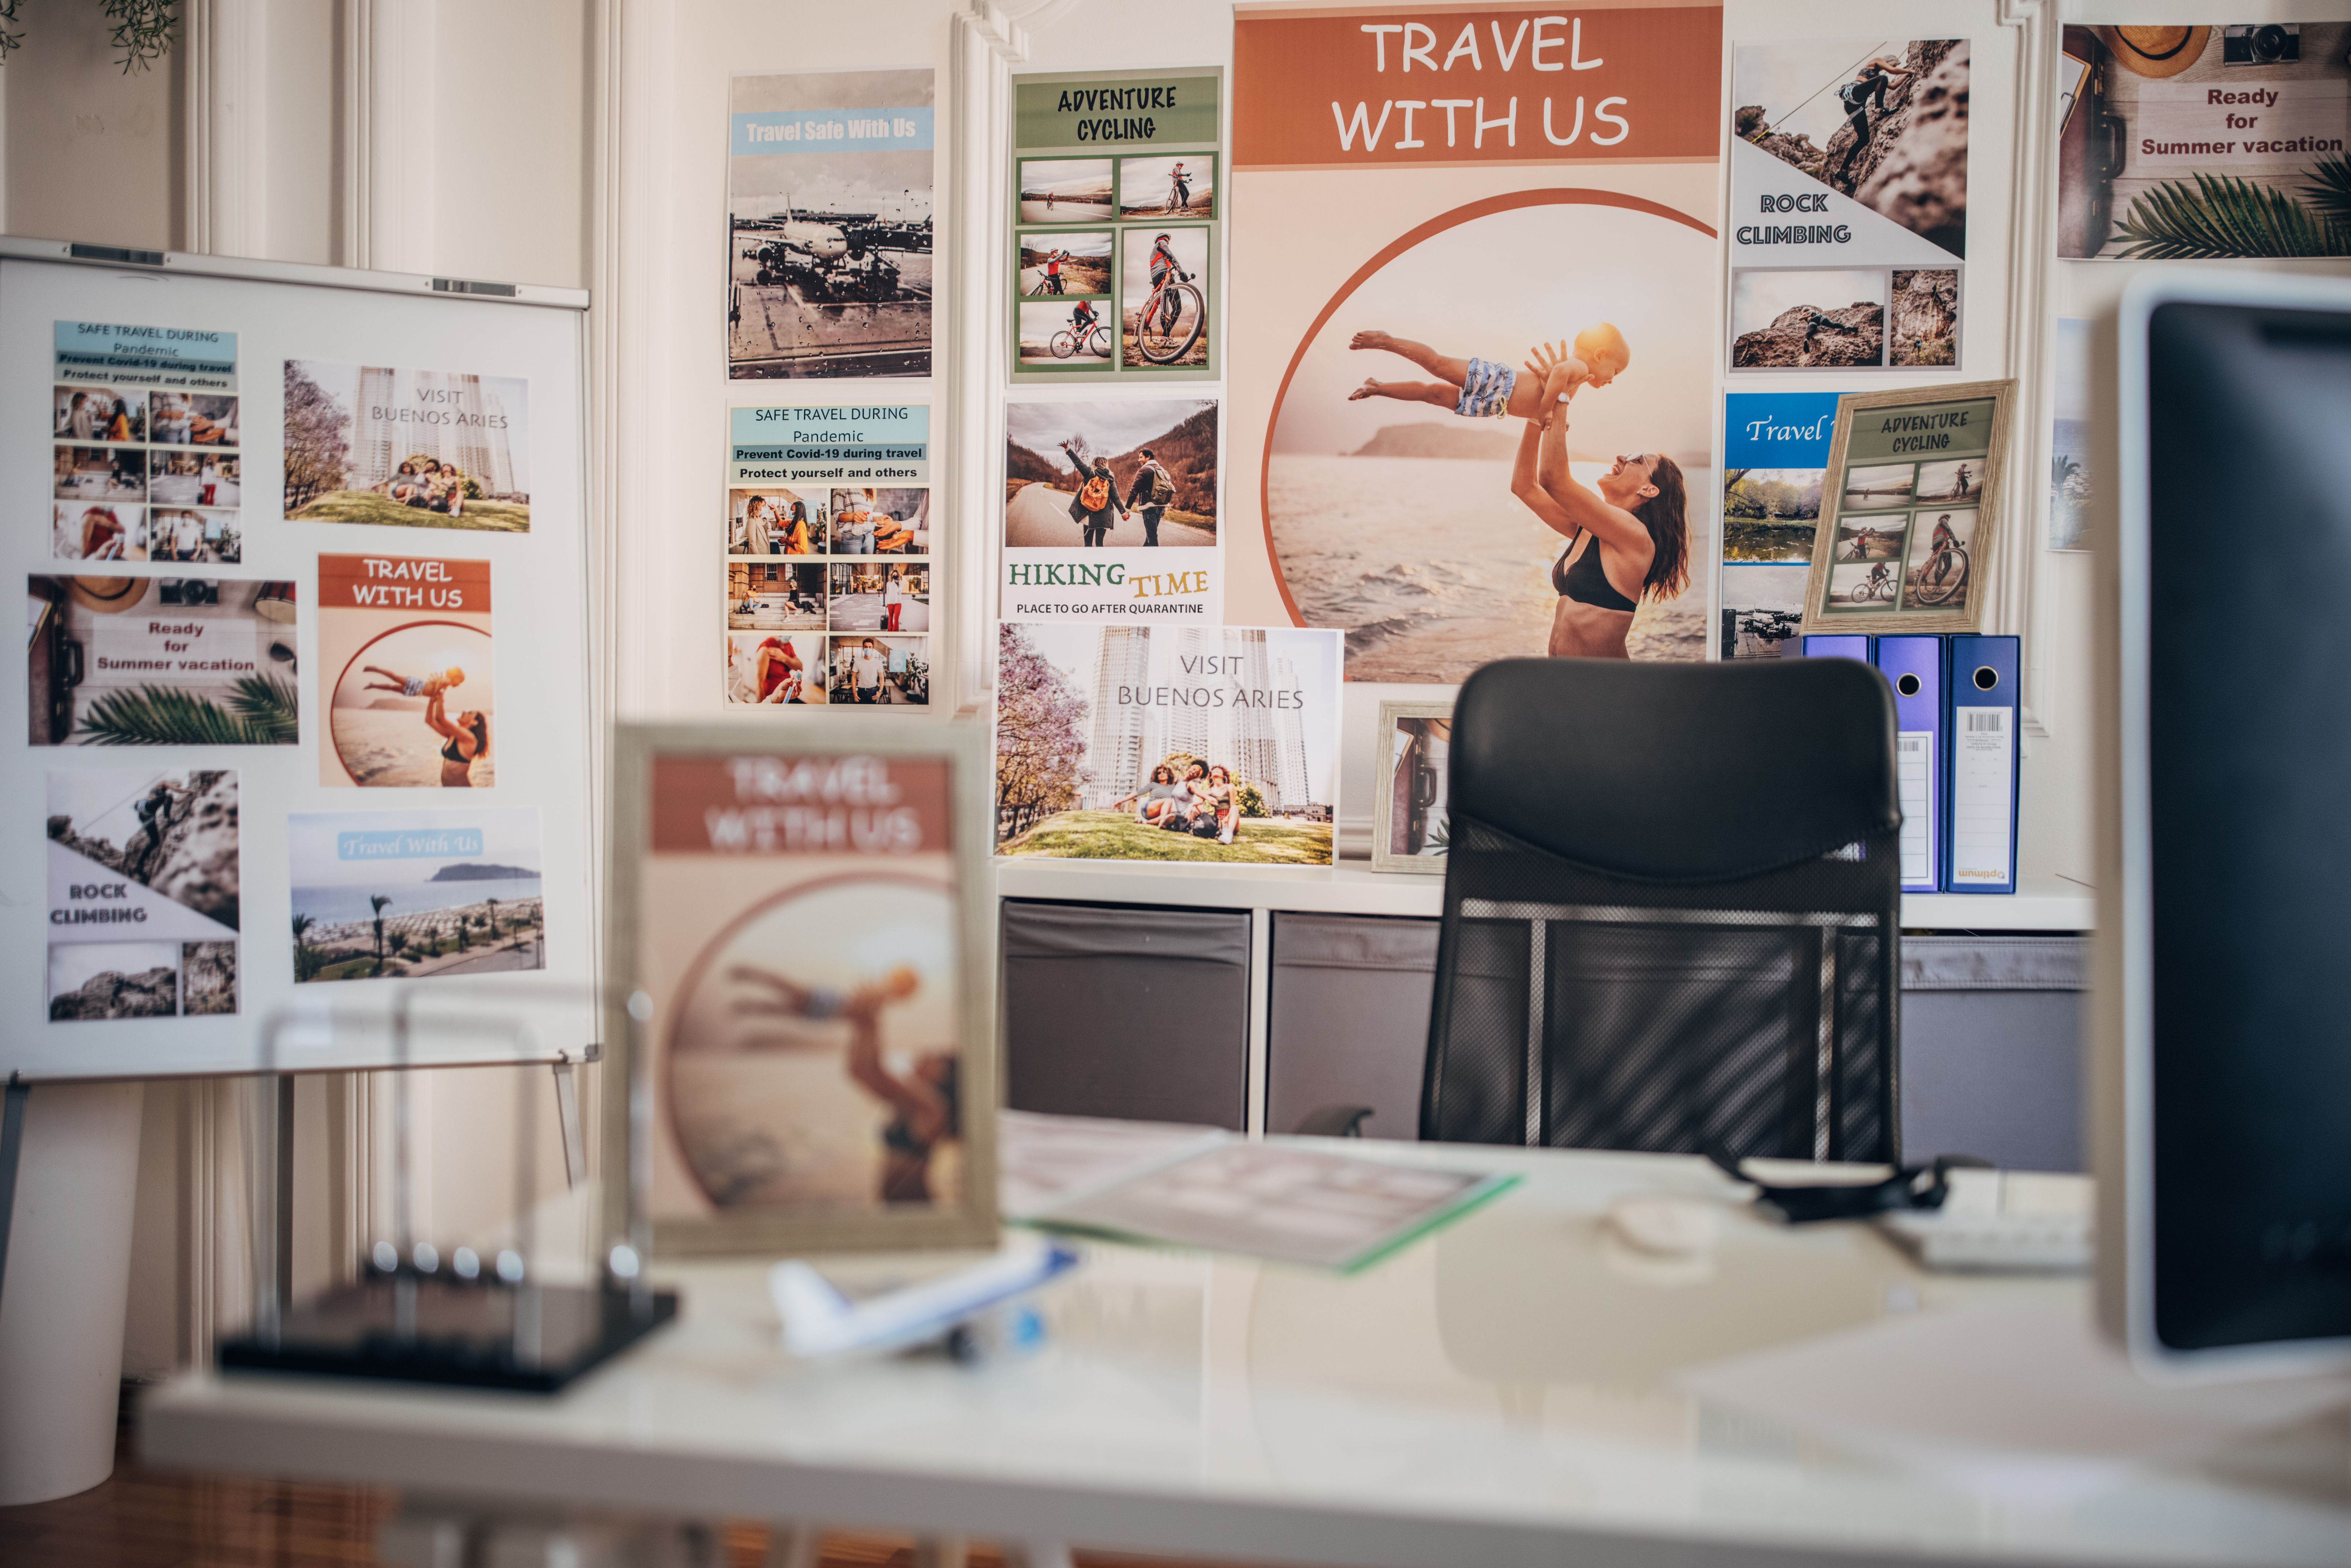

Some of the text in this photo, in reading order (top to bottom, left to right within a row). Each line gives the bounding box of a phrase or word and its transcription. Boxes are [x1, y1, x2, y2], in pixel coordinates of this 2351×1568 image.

[1360, 16, 1603, 72] TRAVEL
[1058, 86, 1177, 113] ADVENTURE
[2208, 88, 2279, 107] Ready
[746, 118, 916, 143] Travel Safe With Us
[1077, 117, 1156, 142] CYCLING
[1331, 95, 1629, 152] WITH US
[2226, 113, 2258, 129] for
[2141, 136, 2344, 155] Summer vacation
[1760, 193, 1829, 213] ROCK
[1736, 224, 1851, 245] CLIMBING
[78, 323, 219, 343] SAFE TRAVEL DURING
[114, 343, 179, 357] Pandemic
[60, 354, 231, 373] Prevent Covid-19 during travel
[63, 369, 227, 387] Protect yourself and others
[417, 388, 464, 404] VISIT
[372, 407, 508, 428] BUENOS ARIES
[755, 407, 909, 421] SAFE TRAVEL DURING
[1881, 411, 1969, 434] ADVENTURE
[793, 429, 864, 442] Pandemic
[1746, 415, 1828, 441] Travel
[1893, 434, 1951, 453] CYCLING
[736, 448, 922, 460] Prevent Covid-19 during travel
[740, 467, 917, 481] Protect yourself and others
[363, 559, 452, 582] TRAVEL
[1009, 563, 1209, 599] HIKING TIME
[352, 584, 463, 608] WITH US
[1017, 604, 1204, 614] PLACE TO GO AFTER QUARANTINE
[149, 622, 204, 637] Ready
[164, 640, 189, 653] for
[97, 657, 255, 671] Summer vacation
[1180, 655, 1244, 675] VISIT
[1118, 686, 1304, 710] BUENOS ARIES
[727, 753, 905, 807] TRAVEL
[703, 803, 926, 854] WITH US
[343, 834, 479, 856] Travel With Us
[1958, 869, 2005, 879] Optimum
[69, 884, 127, 899] ROCK
[49, 907, 148, 925] CLIMBING
